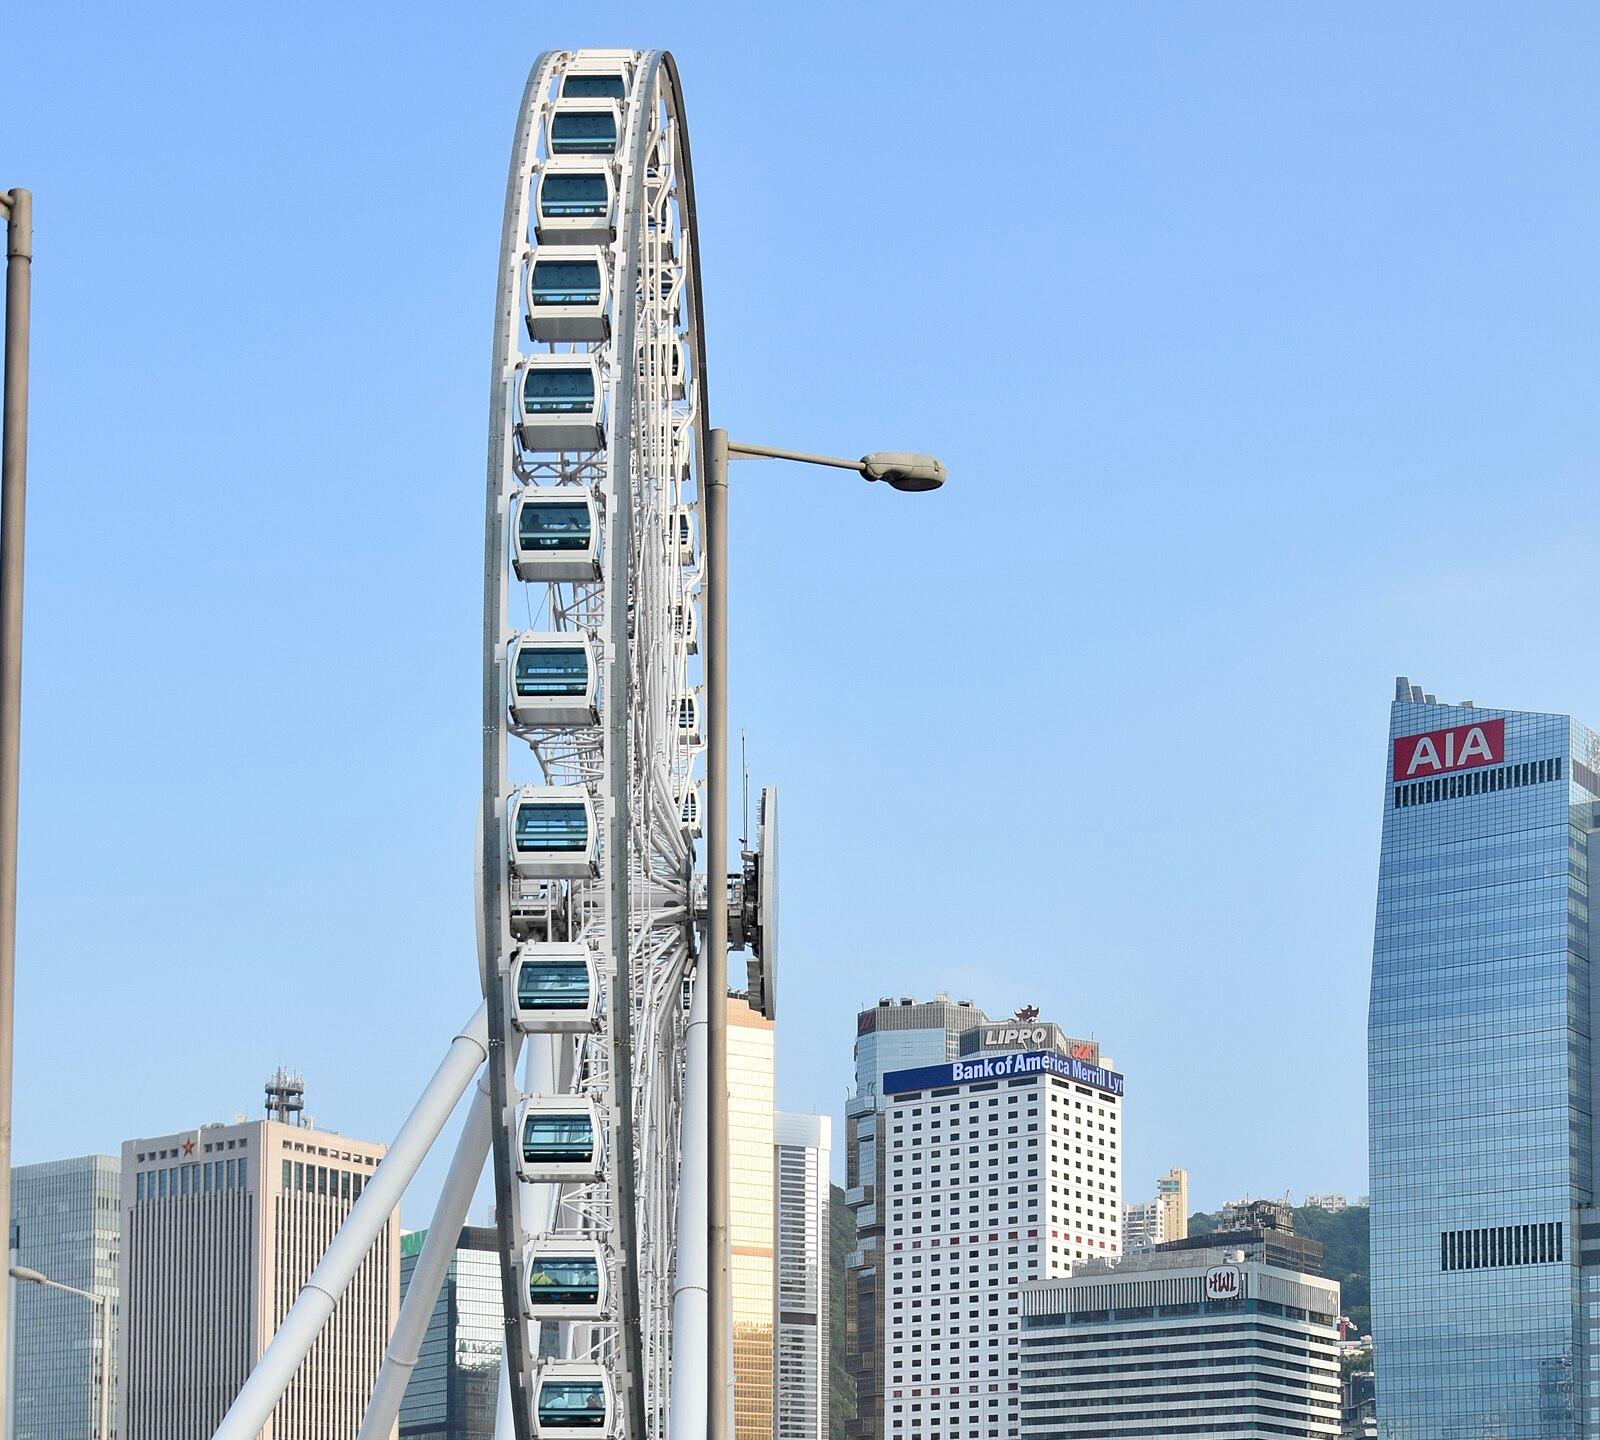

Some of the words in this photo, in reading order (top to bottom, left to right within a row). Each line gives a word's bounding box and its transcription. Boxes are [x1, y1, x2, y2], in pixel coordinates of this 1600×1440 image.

[1406, 727, 1493, 775] AIA
[985, 1028, 1048, 1045] LIPPO
[953, 1059, 994, 1081] Bank
[995, 1056, 1013, 1075] of
[1014, 1053, 1070, 1076] America
[1072, 1062, 1106, 1087] Merrill
[1208, 1271, 1237, 1293] HWL
